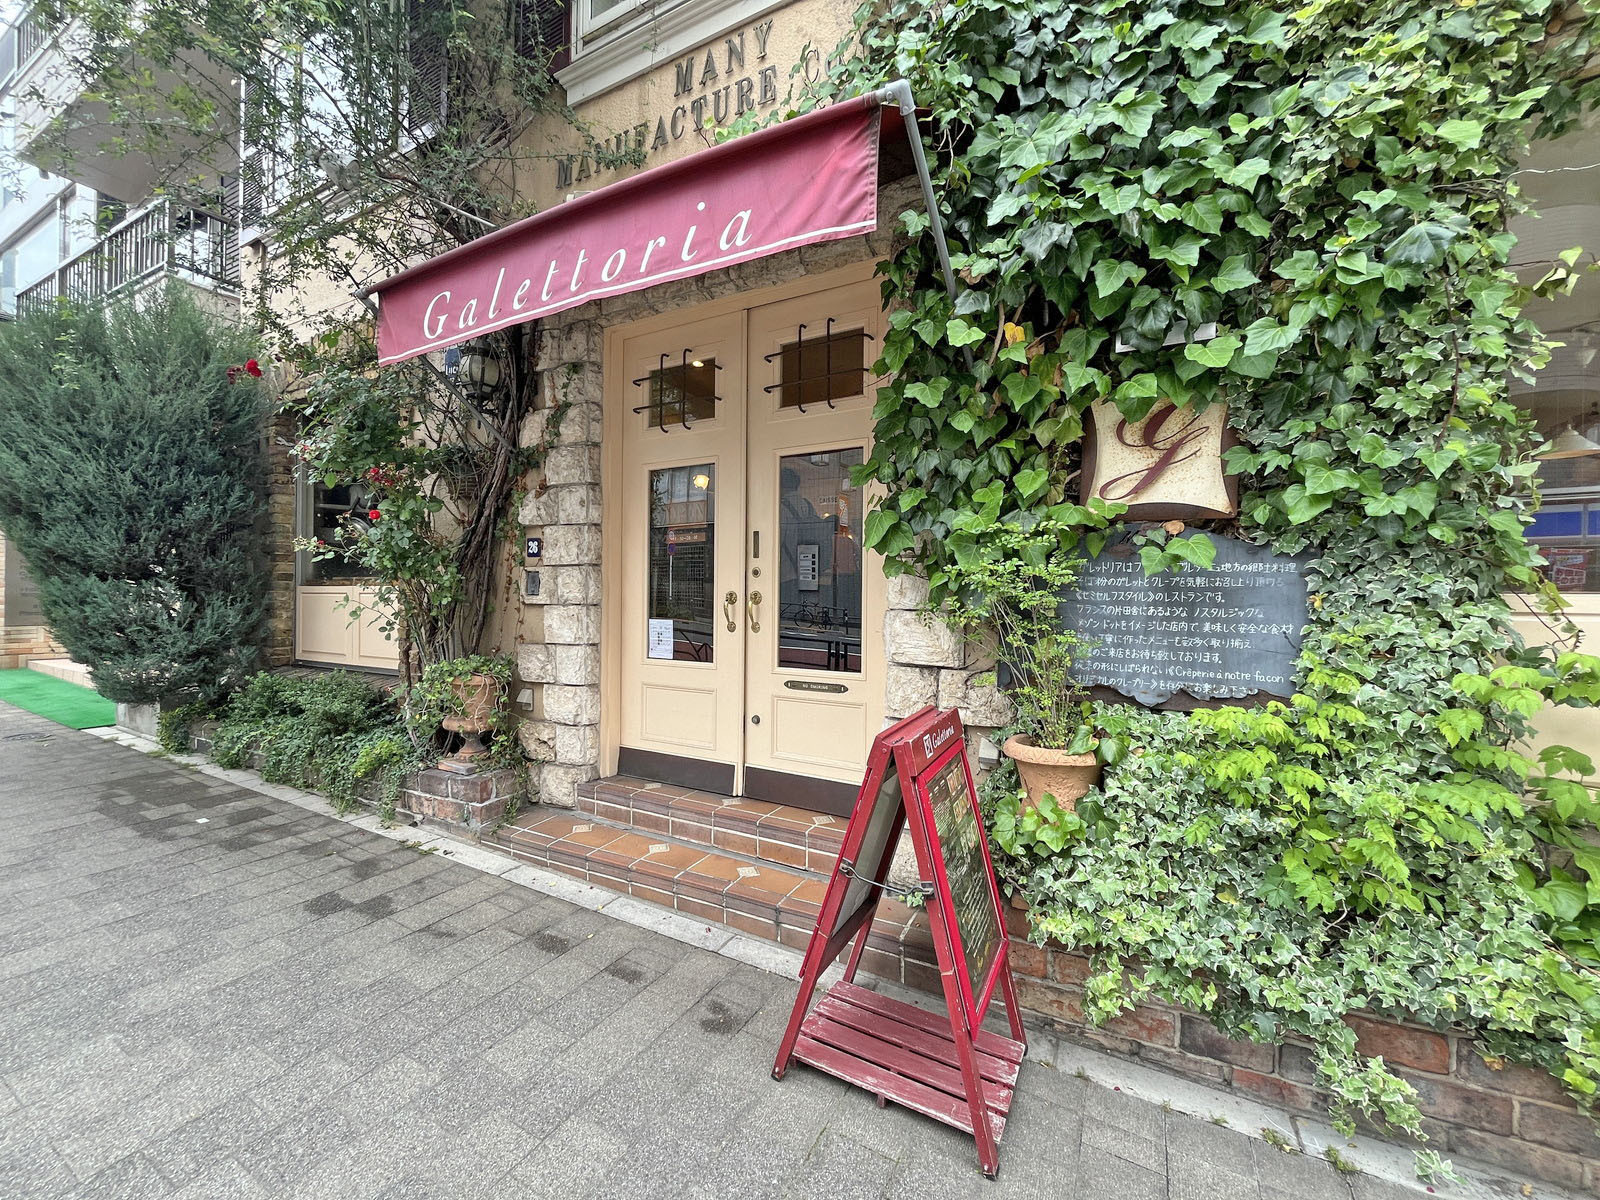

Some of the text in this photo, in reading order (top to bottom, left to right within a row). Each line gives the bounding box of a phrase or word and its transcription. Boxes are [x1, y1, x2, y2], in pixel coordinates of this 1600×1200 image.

[673, 18, 774, 98] MANY
[423, 201, 753, 340] Galettoria
[528, 540, 538, 554] 26
[1224, 670, 1251, 681] notre
